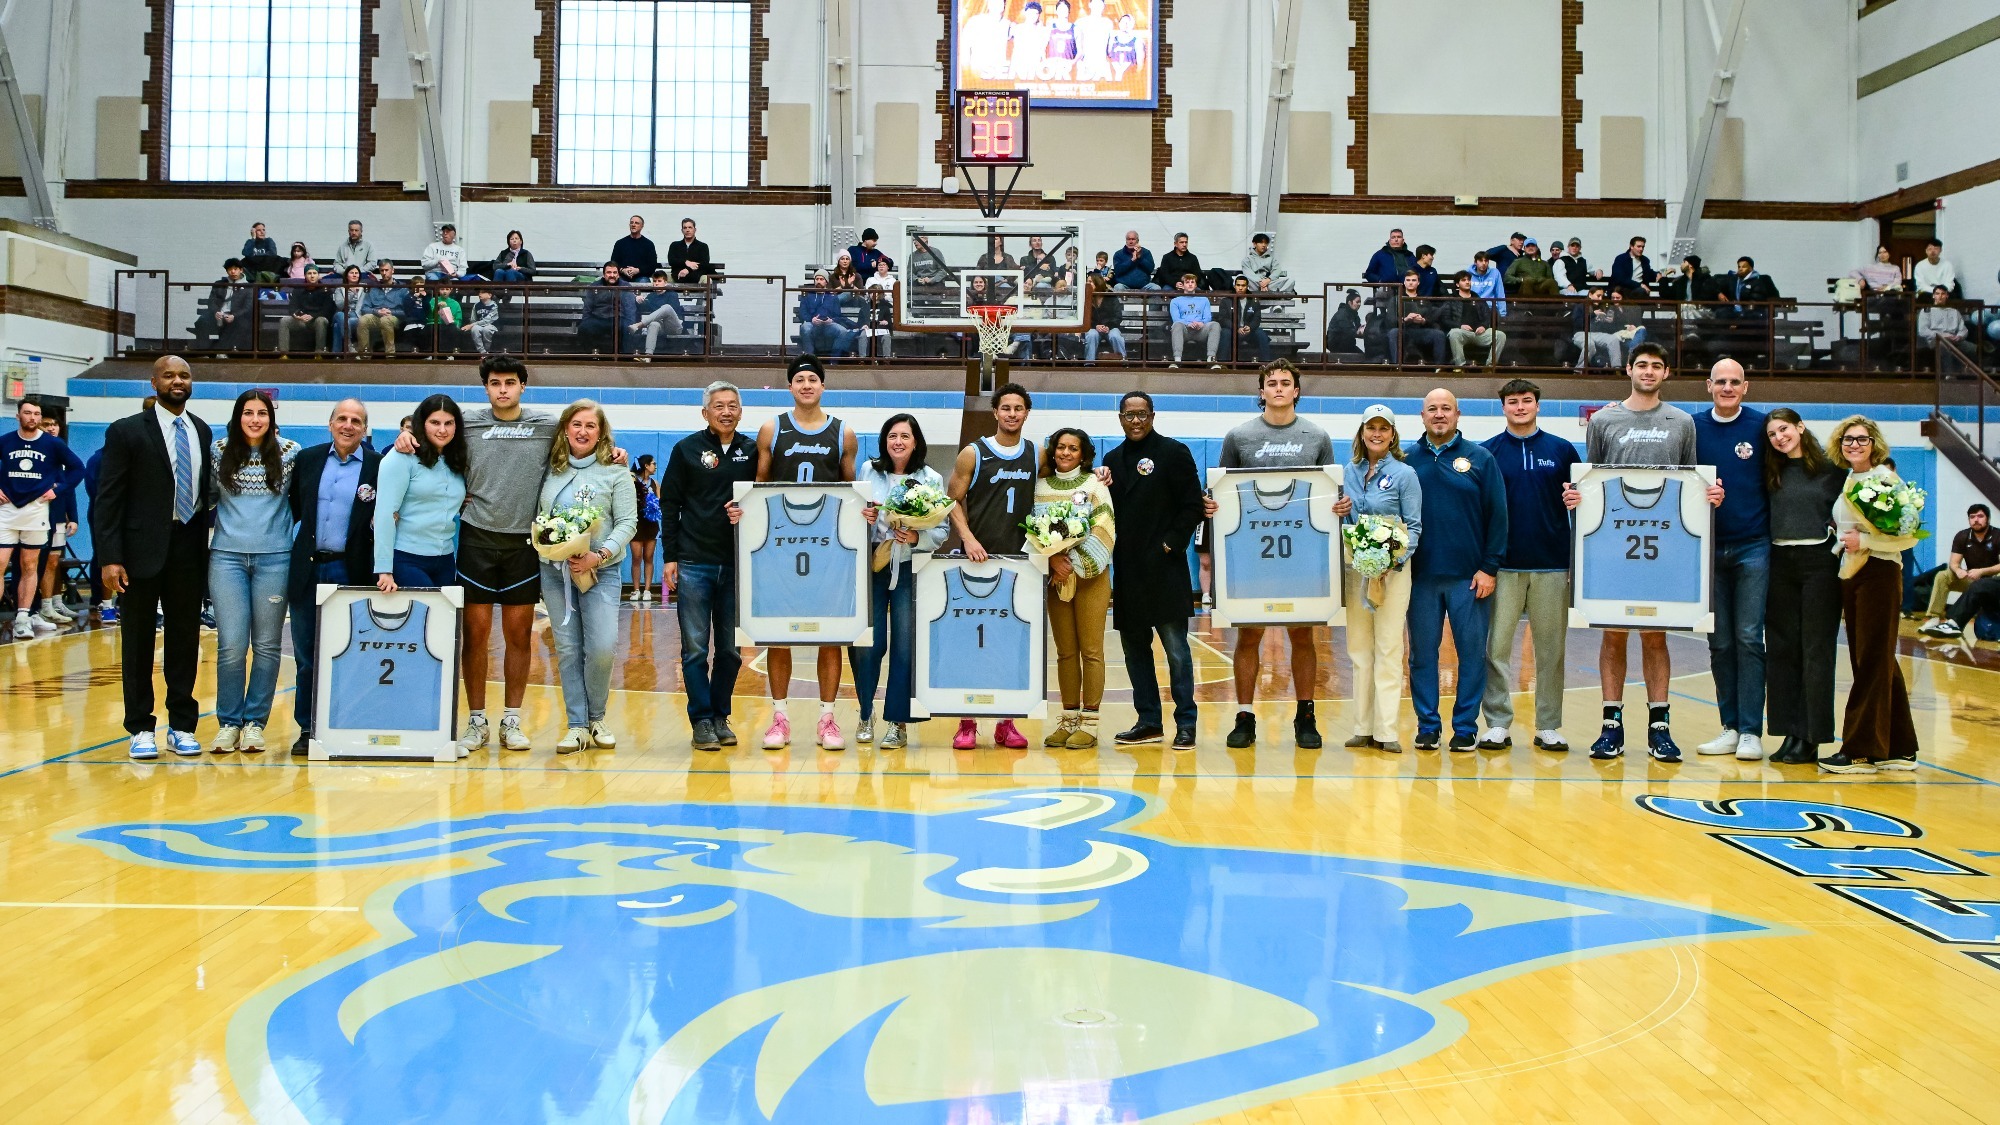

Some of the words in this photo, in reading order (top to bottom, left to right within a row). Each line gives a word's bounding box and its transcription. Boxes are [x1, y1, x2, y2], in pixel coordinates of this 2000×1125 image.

[980, 58, 1072, 81] SENIOR
[1076, 60, 1131, 82] DAY
[964, 98, 1021, 118] 20:00
[972, 120, 1014, 156] 30
[481, 424, 535, 440] Jumbos
[1619, 426, 1670, 444] Jumbos
[8, 449, 47, 462] TRINITY
[1255, 441, 1304, 458] Jumbos
[8, 471, 42, 479] BASKETBALL
[1006, 486, 1016, 514] 1
[1249, 519, 1304, 530] TUFTS
[1613, 519, 1671, 530] TUFTS
[774, 536, 830, 547] TUFTS
[1260, 534, 1293, 559] 20
[1625, 534, 1660, 560] 25
[795, 551, 810, 577] 0
[952, 608, 1009, 618] TUFTS
[976, 623, 984, 648] 1
[359, 641, 418, 653] TUFTS
[378, 658, 395, 685] 2
